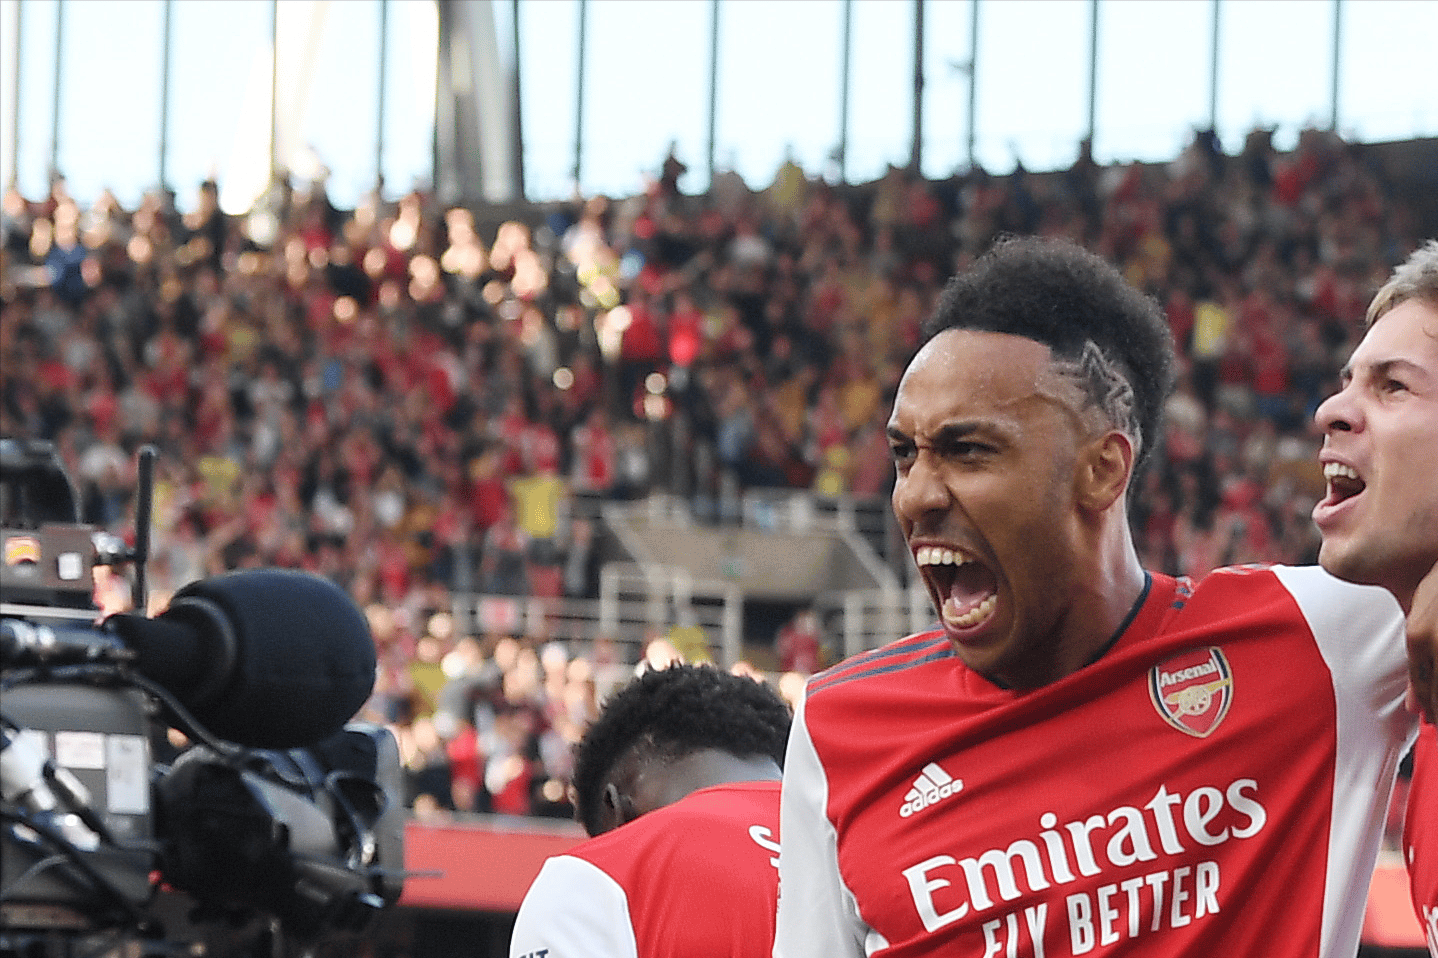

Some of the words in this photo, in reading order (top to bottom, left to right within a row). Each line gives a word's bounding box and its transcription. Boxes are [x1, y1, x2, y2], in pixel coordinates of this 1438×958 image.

[1160, 658, 1218, 689] Arsenal
[899, 778, 964, 818] adidas
[902, 778, 1267, 933] Emirates
[1066, 860, 1221, 956] BETTER
